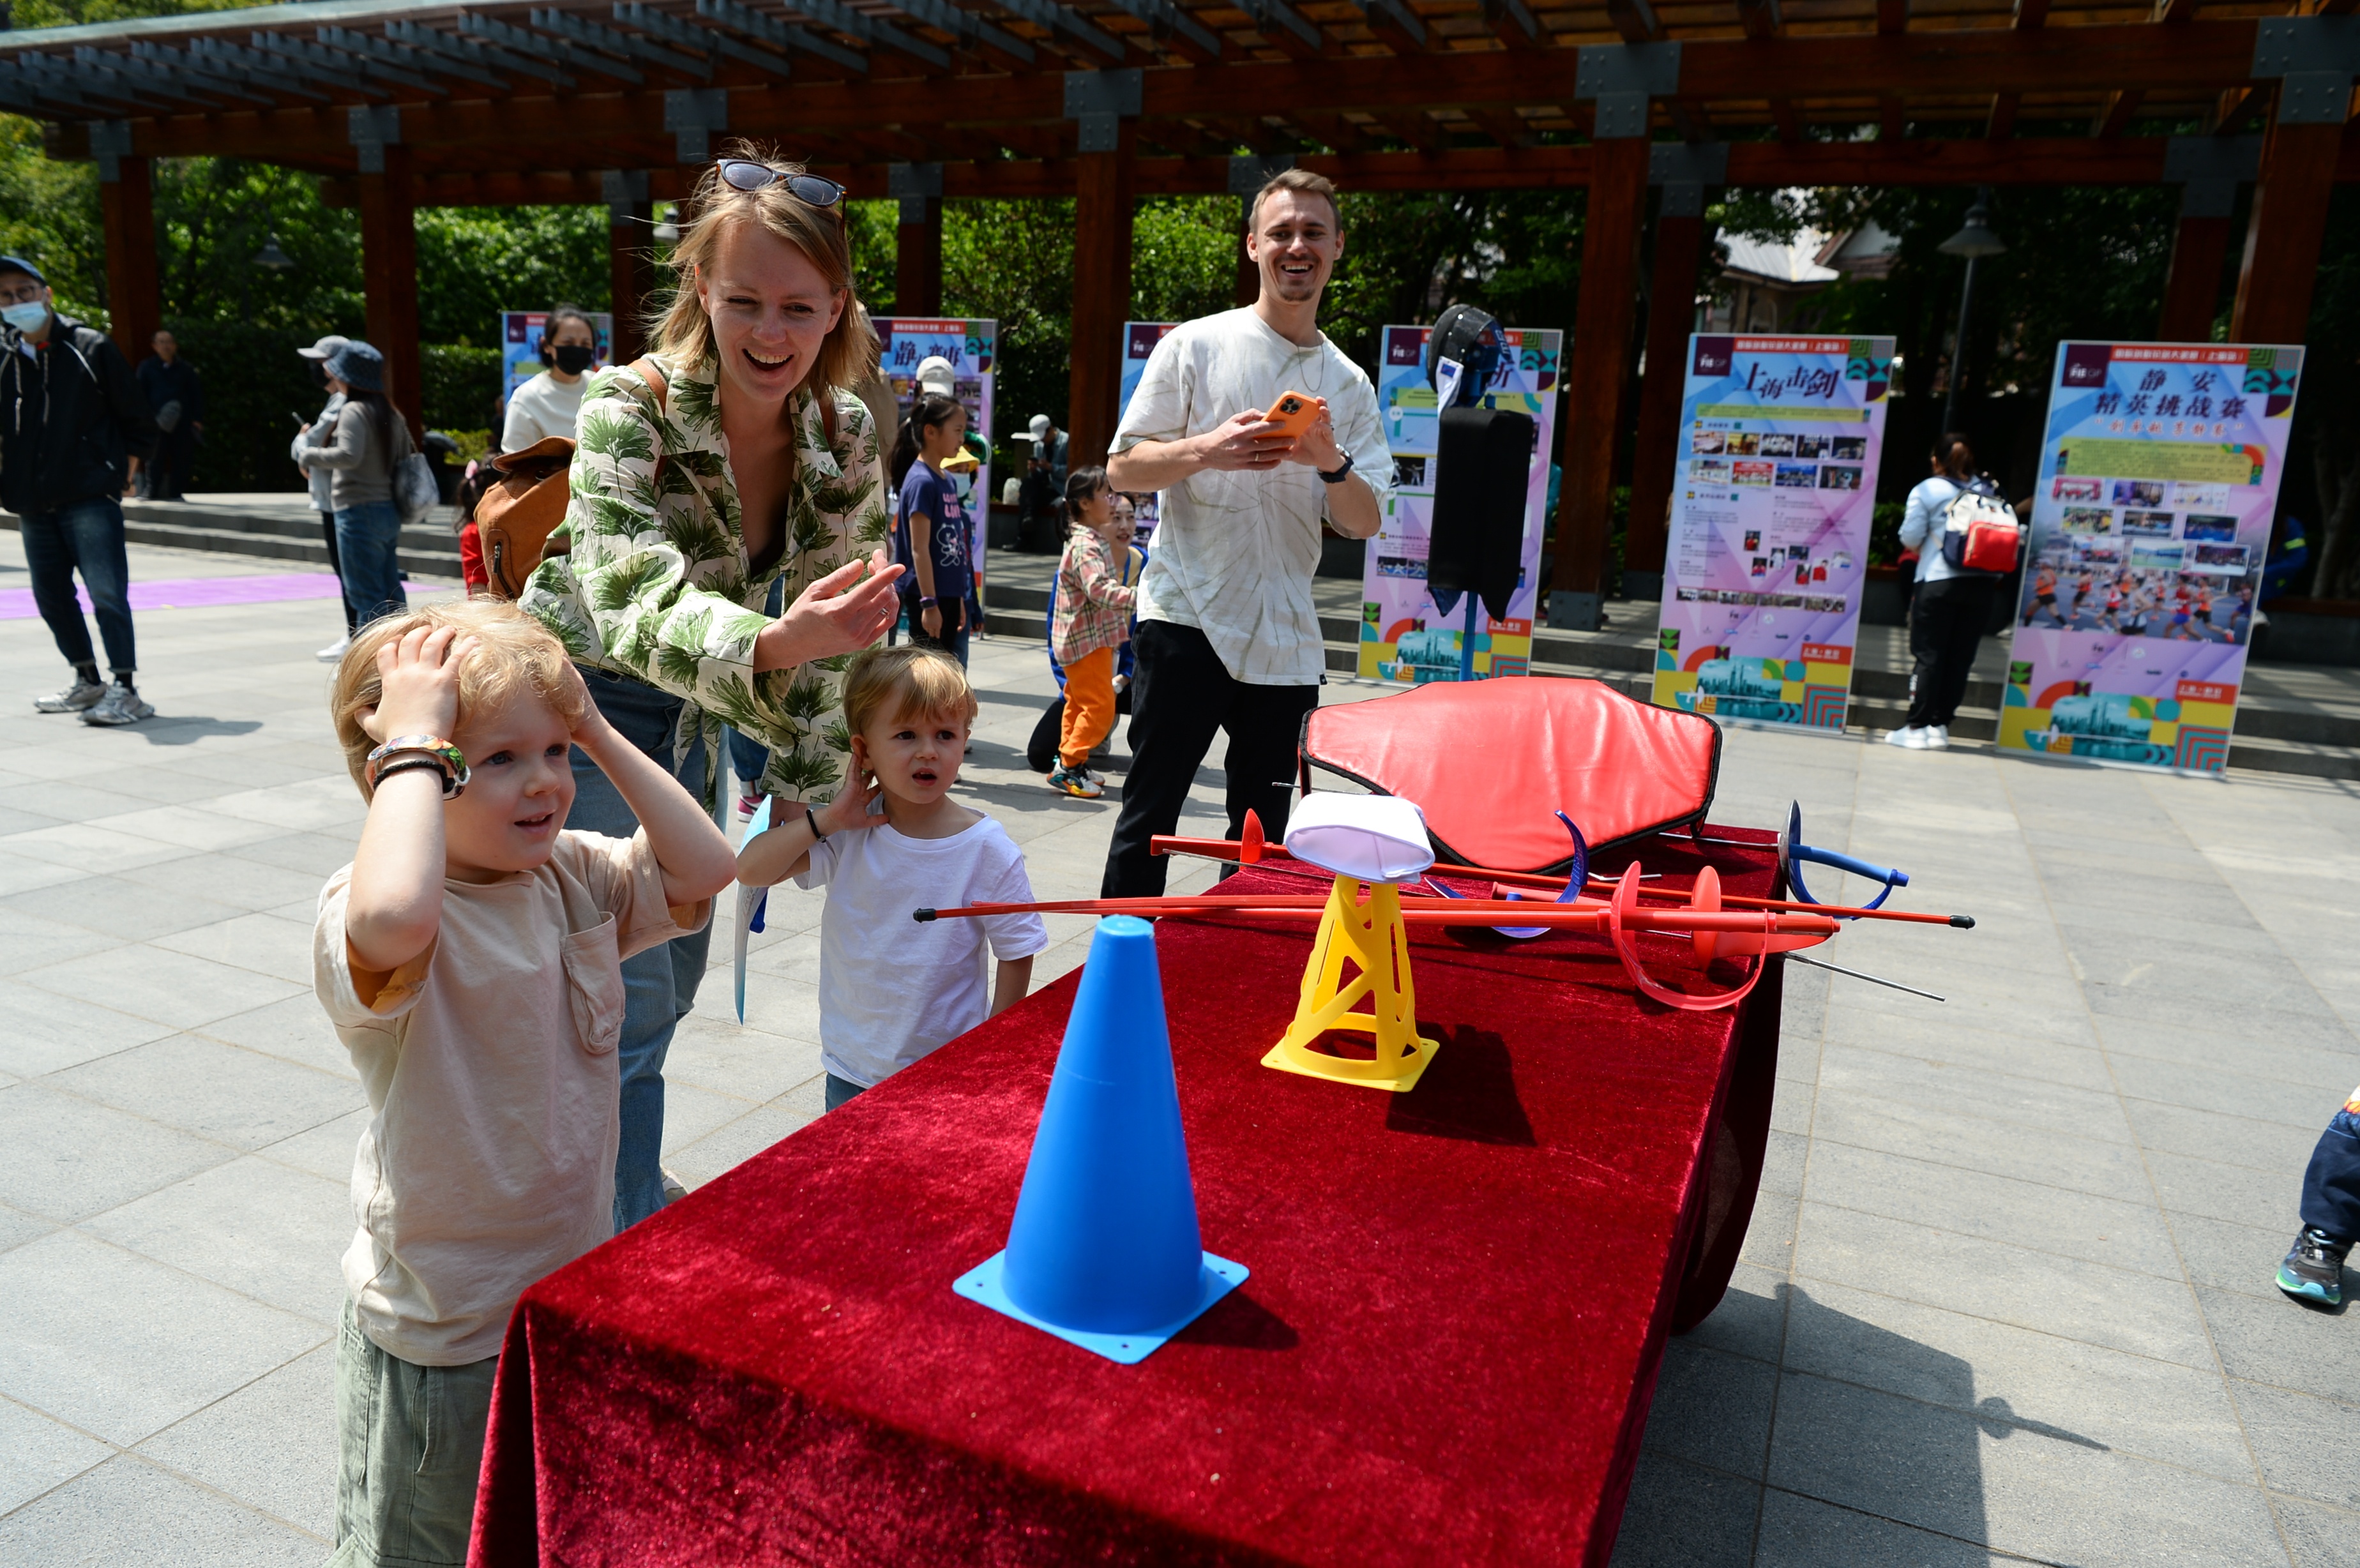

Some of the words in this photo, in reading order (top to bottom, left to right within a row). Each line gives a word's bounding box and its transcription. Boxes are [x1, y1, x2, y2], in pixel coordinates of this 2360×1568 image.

[1734, 362, 1841, 399] 上海击剑
[2094, 393, 2247, 420] 精英挑战赛
